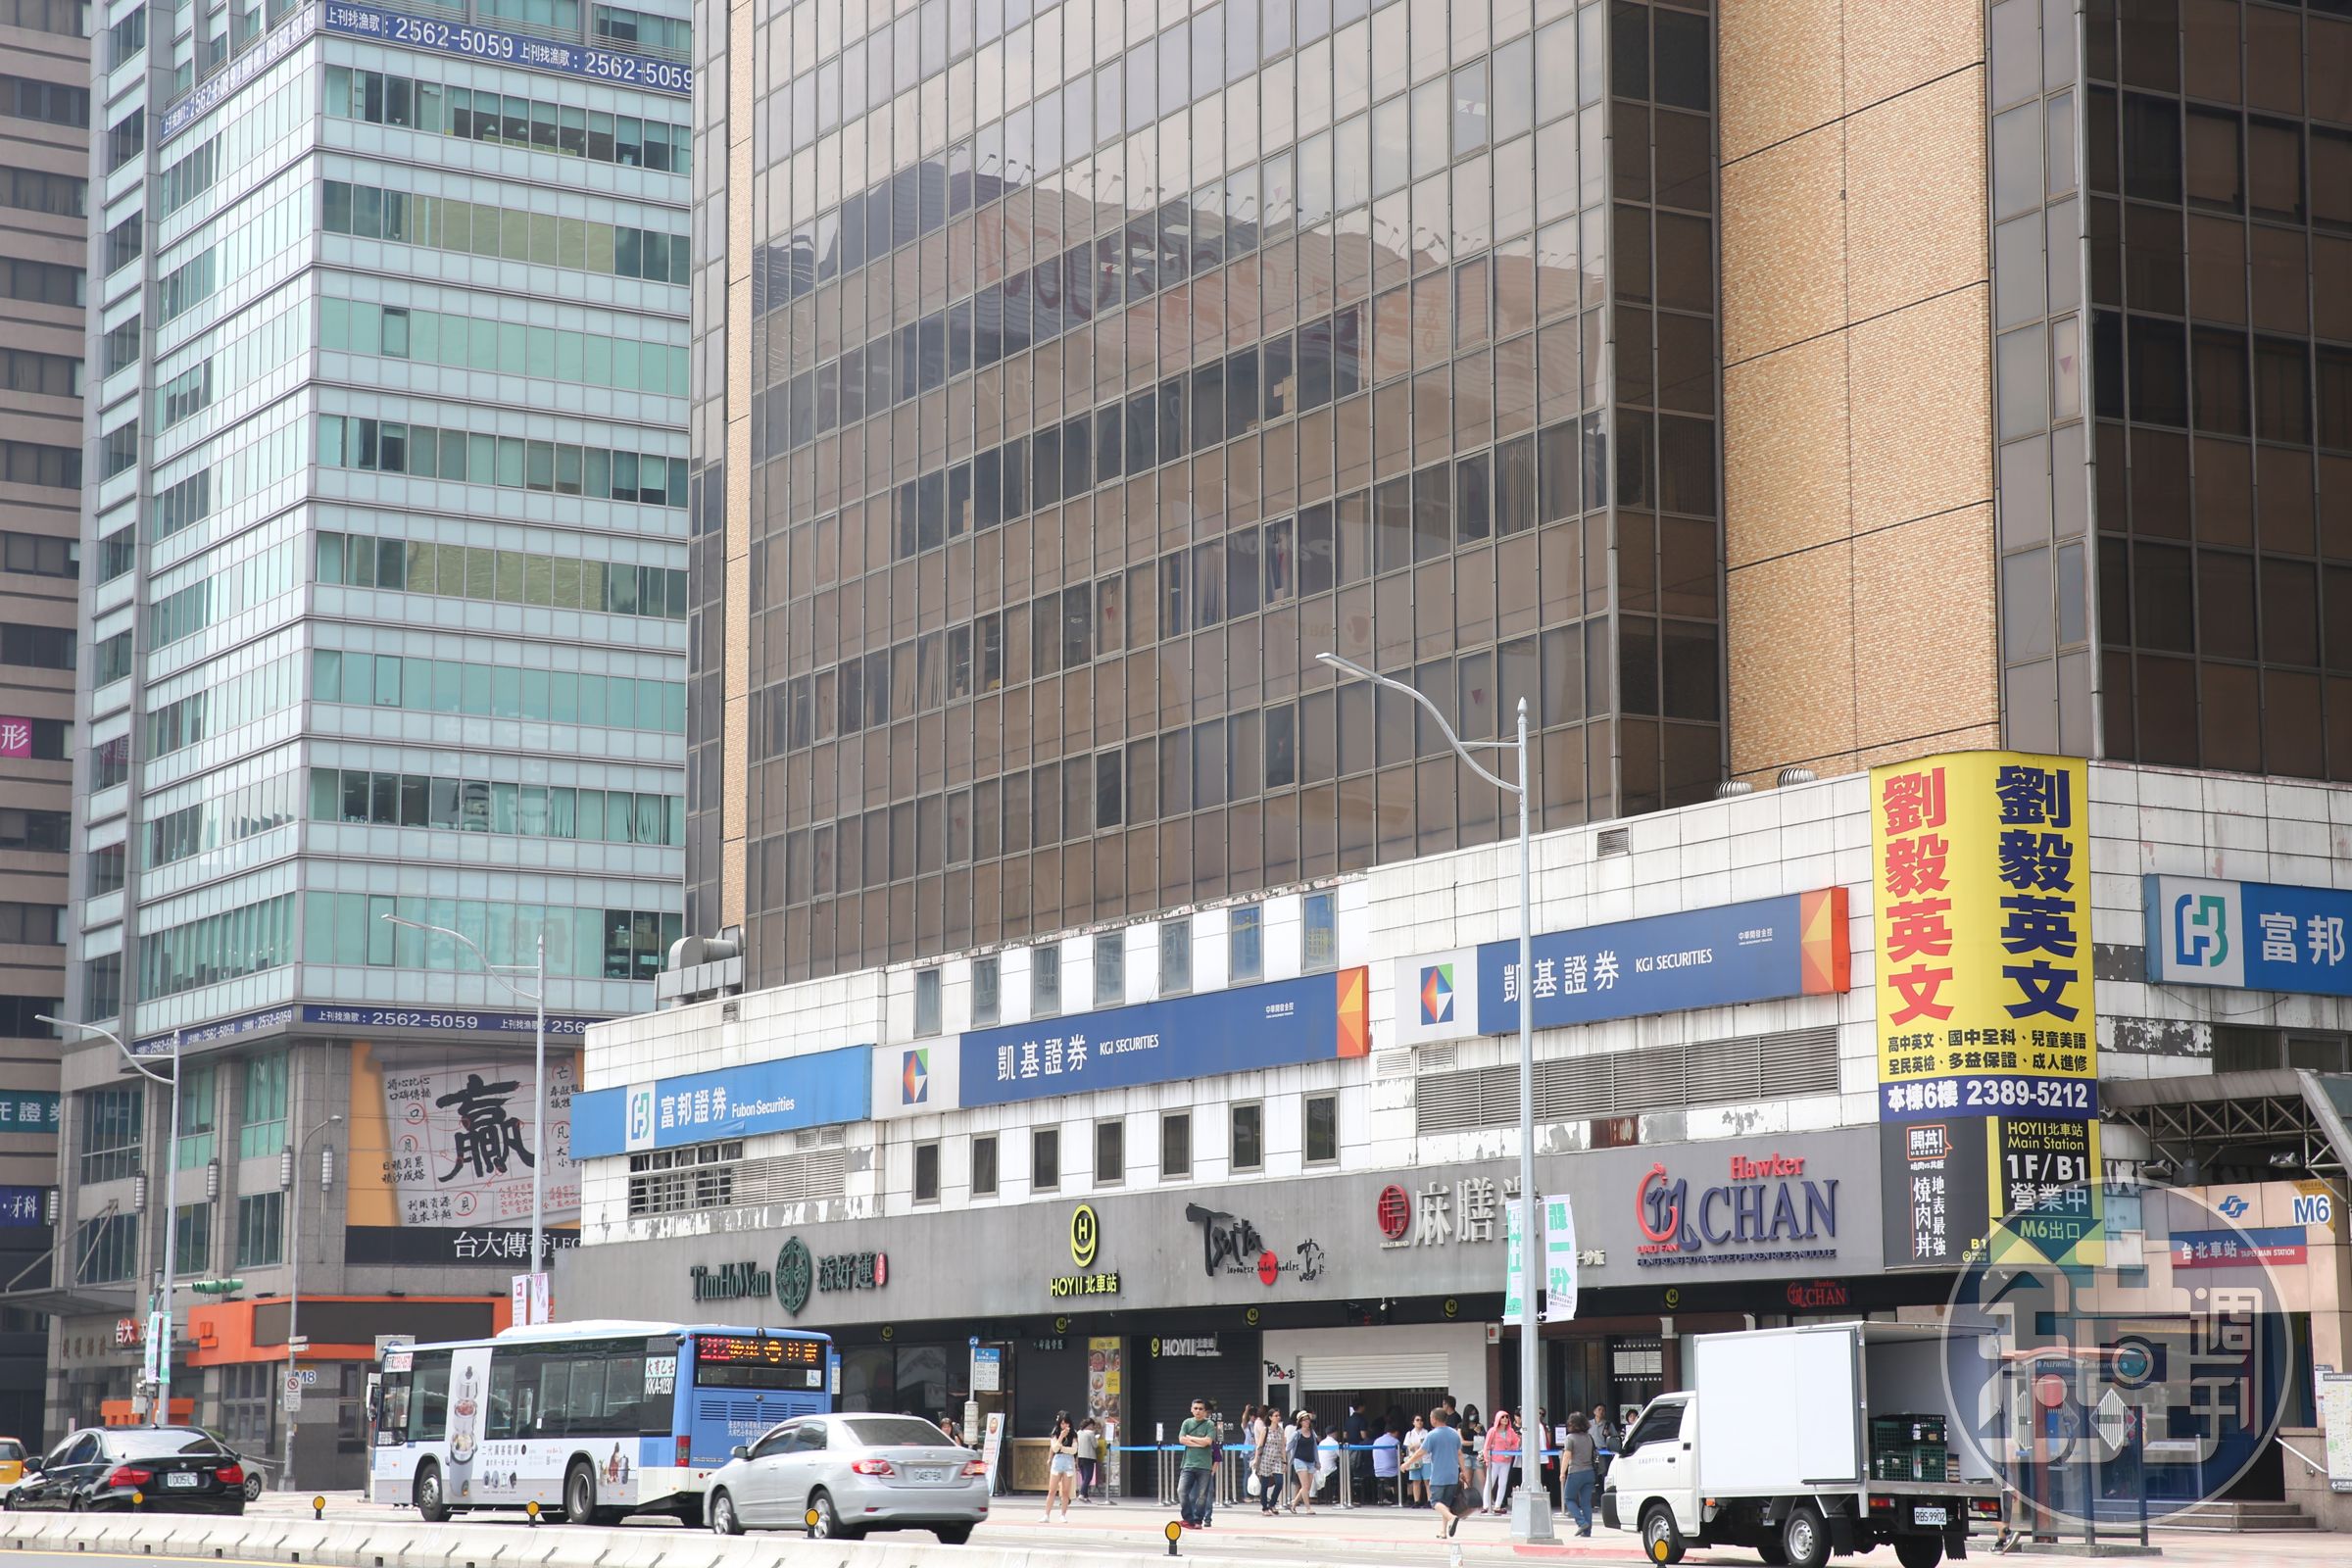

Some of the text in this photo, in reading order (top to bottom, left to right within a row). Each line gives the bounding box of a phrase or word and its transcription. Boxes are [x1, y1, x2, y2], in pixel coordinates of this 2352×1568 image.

[395, 17, 514, 59] 2562-5059
[584, 51, 693, 90] 2562-5059
[1, 724, 28, 751] 形
[1882, 766, 1954, 1026] 劉毅英文
[1995, 764, 2080, 1022] 劉毅英文
[2260, 911, 2346, 966] 富邦
[1503, 948, 1713, 1004] 凱基證券 KGI SECURITIES
[372, 1011, 478, 1029] 2562-5059
[997, 1034, 1159, 1081] 凱基證券 KGI SECURITIES
[661, 1086, 795, 1130] 富邦證券 Fubon Securities
[1887, 1079, 2088, 1112] 本棟6樓 2389-5212
[2007, 1136, 2084, 1151] Main Station
[1730, 1152, 1804, 1181] Hawker
[1698, 1179, 1839, 1246] CHAN
[2011, 1182, 2087, 1213] 營業中
[2293, 1195, 2331, 1225] M6
[1913, 1177, 1934, 1258] 燒肉丼
[1932, 1175, 1946, 1256] 地表最強
[2020, 1220, 2081, 1240] M6出口
[1661, 1244, 1680, 1252] FAN
[1970, 1238, 1986, 1250] B1
[2181, 1240, 2237, 1260] 台北車站
[2258, 1249, 2272, 1257] MAIN
[2273, 1248, 2295, 1256] STATION
[690, 1260, 772, 1301] TimHoWan
[816, 1252, 876, 1293] 添好運
[1051, 1273, 1118, 1297] HOYII 北車站
[1805, 1287, 1847, 1305] CHAN
[1161, 1339, 1196, 1356] HOYII
